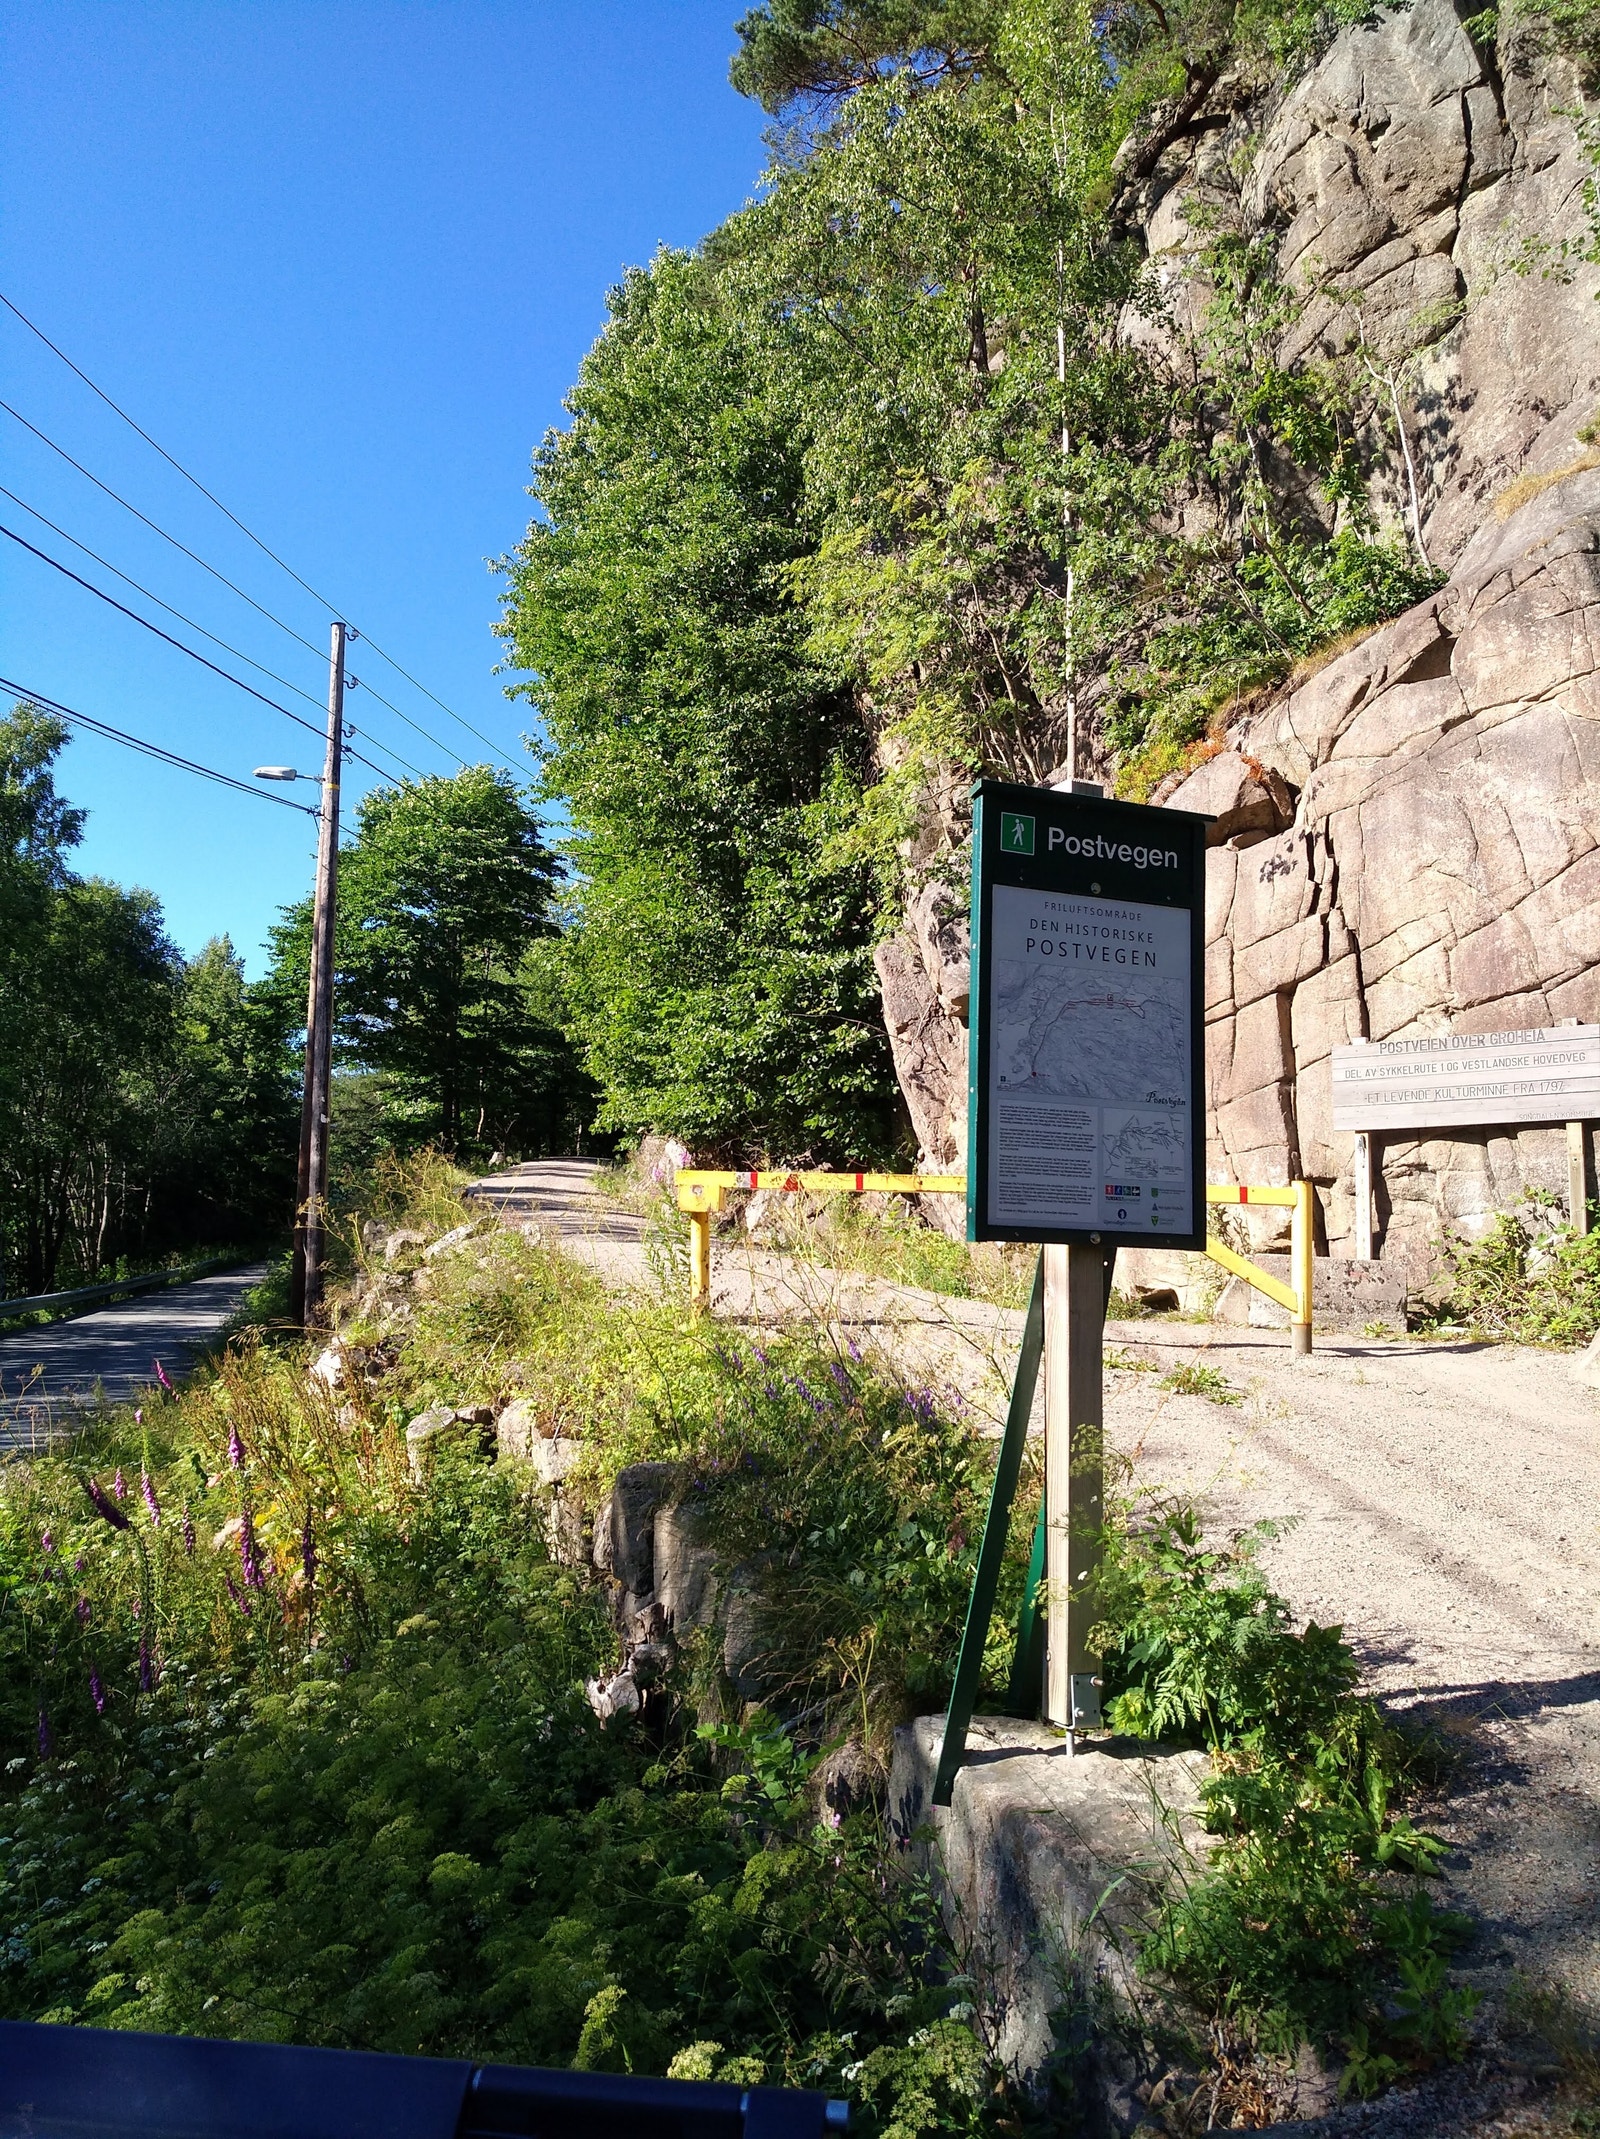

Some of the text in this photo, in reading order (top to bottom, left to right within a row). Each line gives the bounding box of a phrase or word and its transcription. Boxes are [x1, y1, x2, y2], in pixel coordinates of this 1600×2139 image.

[1048, 826, 1178, 869] Postvegen
[1044, 901, 1142, 922] FRILUFTSOMRÅDE
[1029, 918, 1153, 944] DEN HISTORISKE
[1026, 937, 1157, 967] POSTVEGEN
[1379, 1029, 1546, 1054] POSTVEIEN OVER GROHEIA
[1345, 1069, 1362, 1079] DEL
[1365, 1068, 1377, 1078] AV
[1379, 1063, 1438, 1077] SYKKELRUTE
[1446, 1062, 1459, 1072] OG
[1462, 1056, 1530, 1070] VESTLANDSKE
[1533, 1052, 1586, 1065] HOVEDVEG
[1384, 1090, 1431, 1102] LEVENDE
[1434, 1084, 1509, 1099] KULTURMINNE
[1513, 1082, 1535, 1094] FRA
